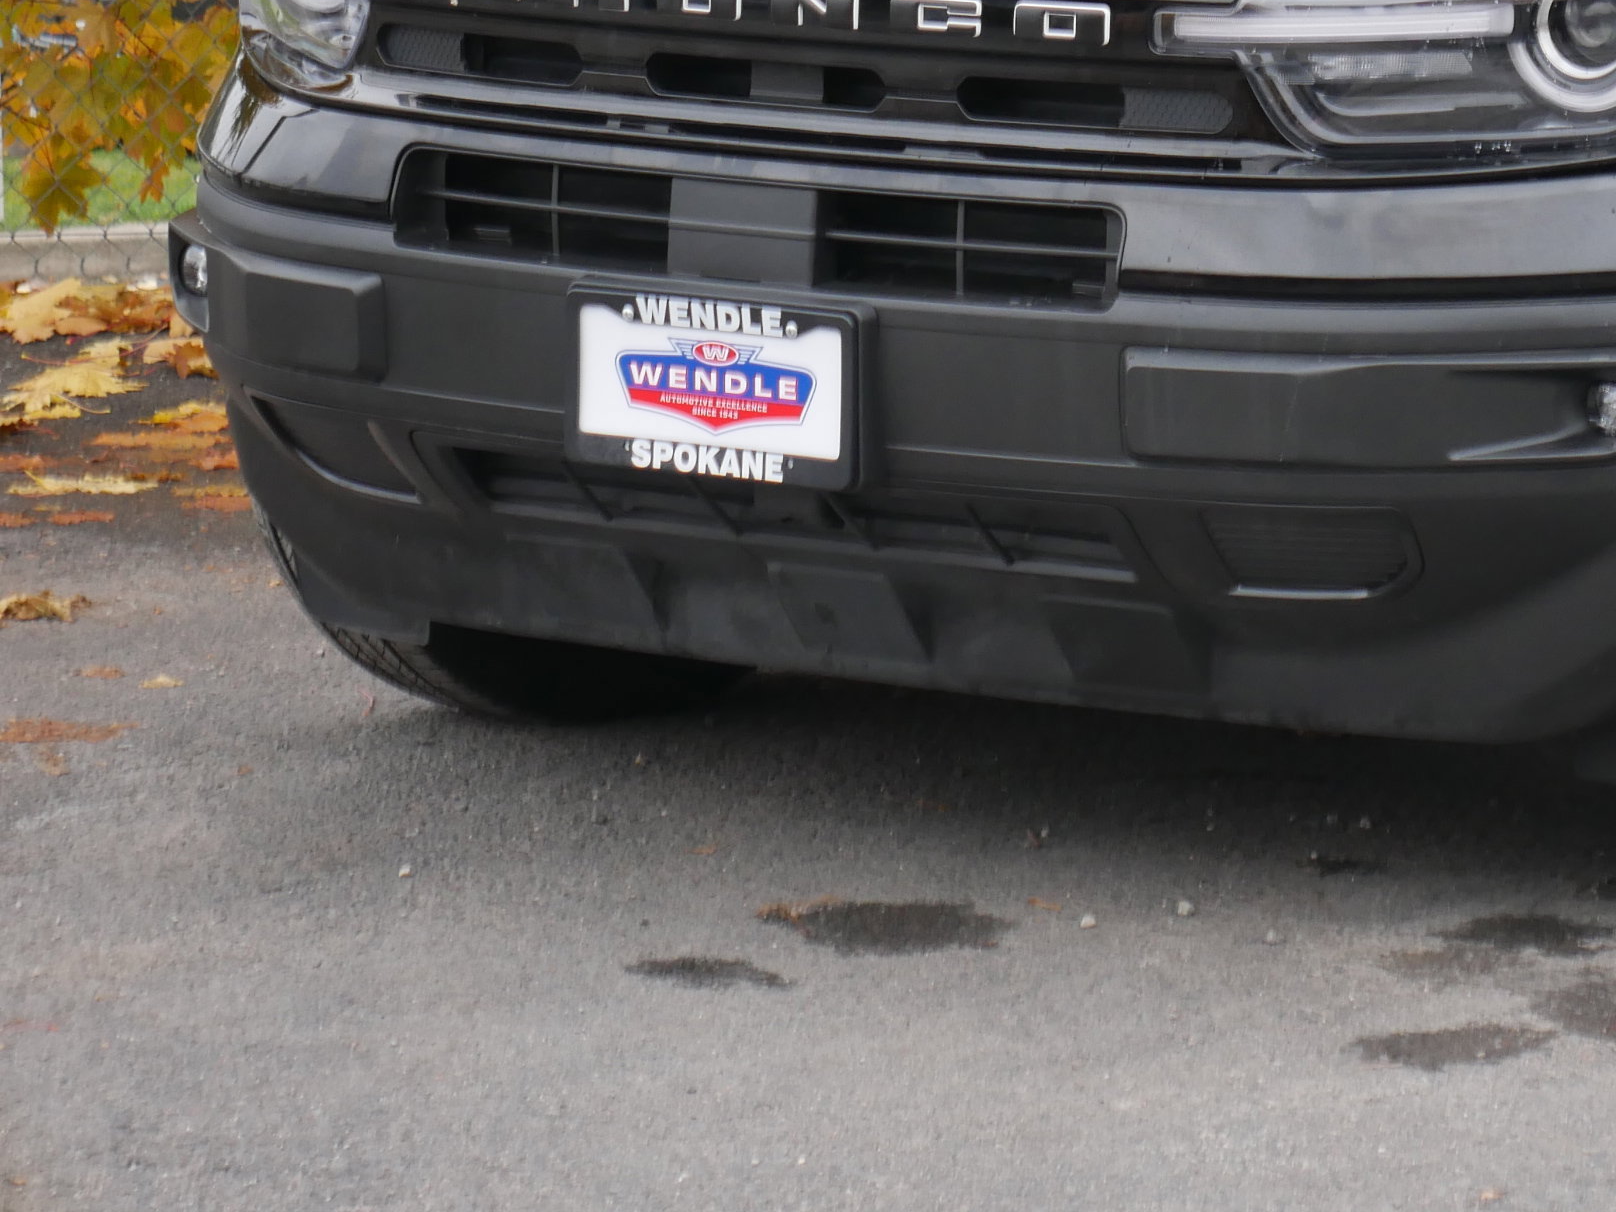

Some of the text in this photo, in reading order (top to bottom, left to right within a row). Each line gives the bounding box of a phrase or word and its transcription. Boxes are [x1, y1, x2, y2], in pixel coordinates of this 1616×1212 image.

[635, 292, 784, 338] WENDLE
[629, 361, 798, 401] WENDLE
[659, 392, 768, 413] AUTOMOTIVE EXCELLENCE
[692, 406, 717, 418] SINCE
[630, 439, 784, 484] SPOKANE
